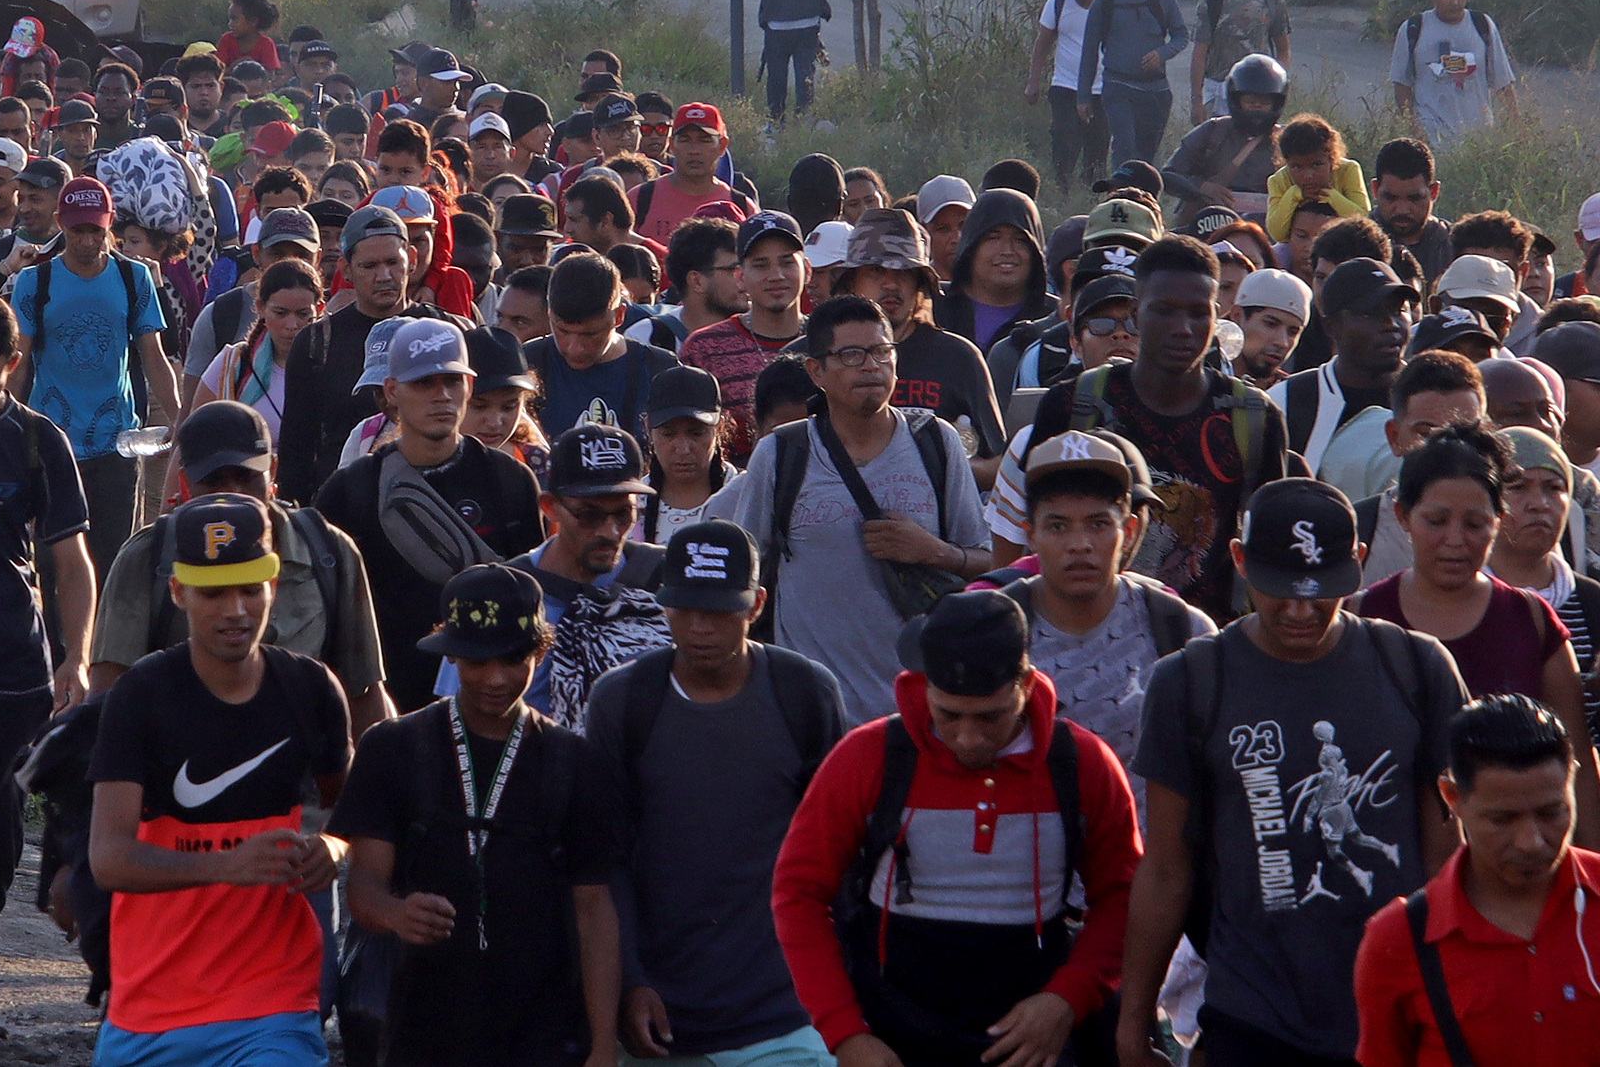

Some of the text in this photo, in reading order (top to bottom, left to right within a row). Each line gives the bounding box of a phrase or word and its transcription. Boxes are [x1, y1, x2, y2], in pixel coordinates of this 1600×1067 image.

[64, 192, 103, 204] ORESKY
[1111, 202, 1128, 224] LA
[409, 330, 457, 359] Dodgers
[581, 437, 625, 455] MAD
[1060, 434, 1093, 460] NY
[203, 520, 238, 559] P
[1229, 720, 1286, 770] 23
[1286, 749, 1399, 824] Fght
[1239, 766, 1298, 911] MICHAEL JORDAN
